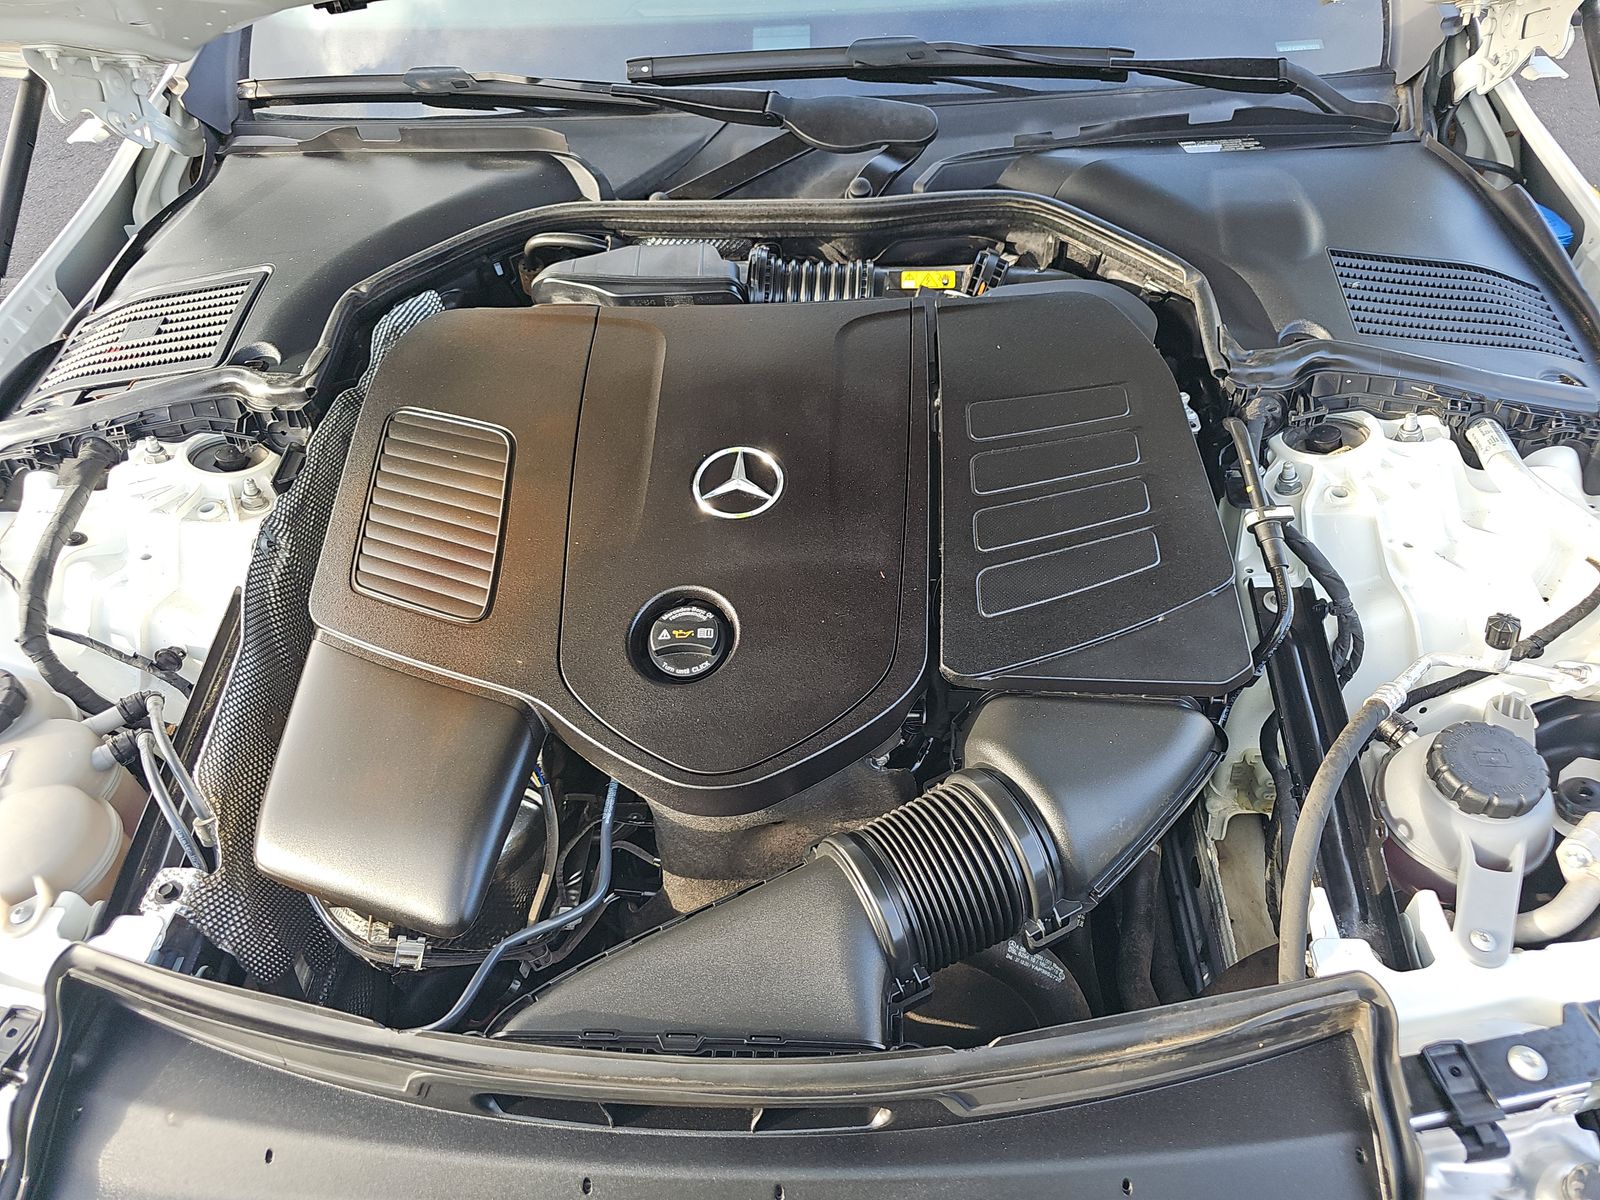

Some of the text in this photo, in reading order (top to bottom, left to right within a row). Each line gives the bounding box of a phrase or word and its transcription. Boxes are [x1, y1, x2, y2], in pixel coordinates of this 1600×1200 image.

[661, 606, 707, 620] Mercedes-Benz
[668, 611, 708, 621] recommended
[662, 661, 675, 673] Turn
[691, 660, 711, 673] CLICK
